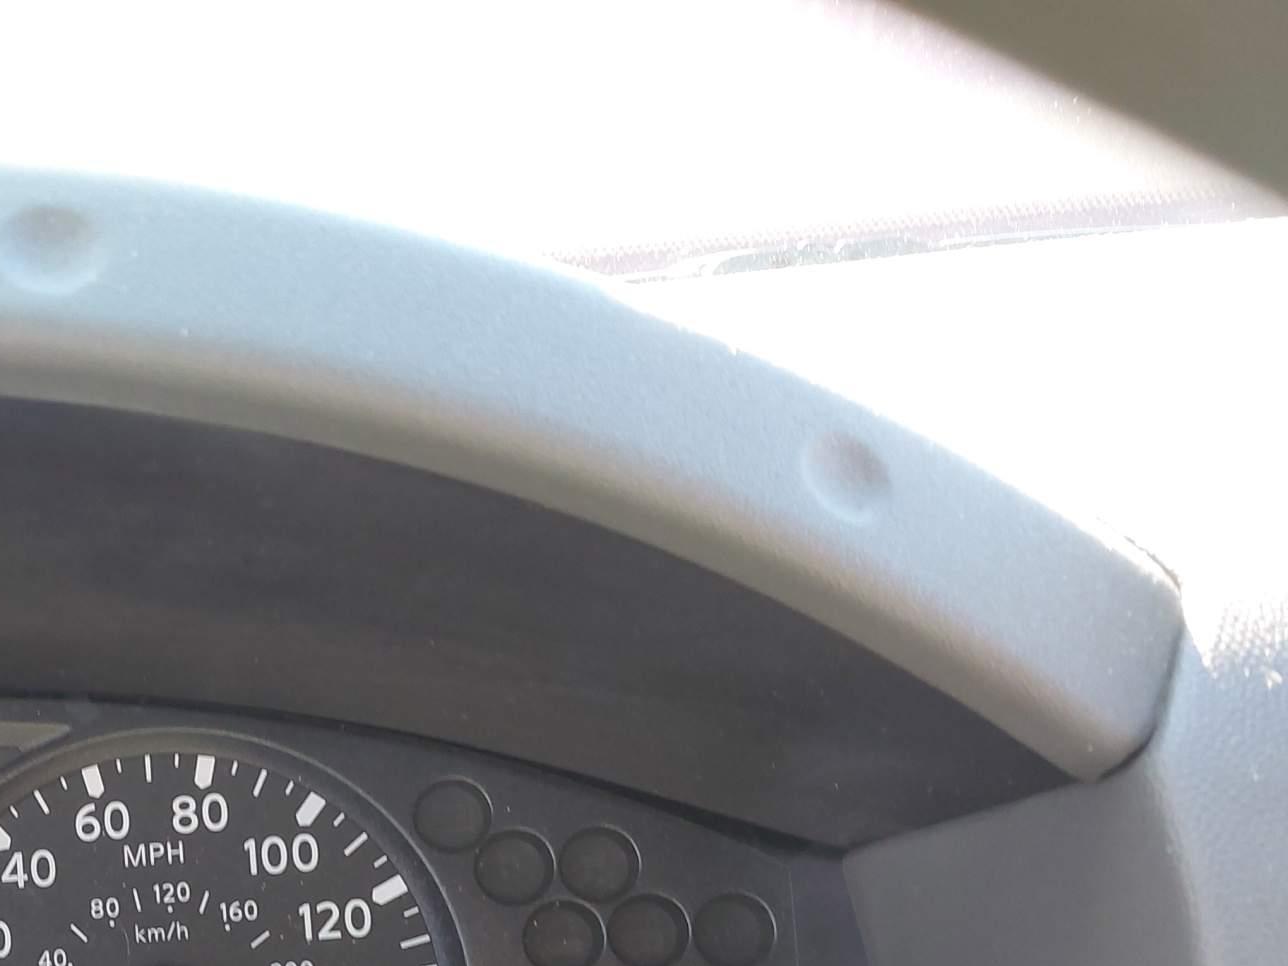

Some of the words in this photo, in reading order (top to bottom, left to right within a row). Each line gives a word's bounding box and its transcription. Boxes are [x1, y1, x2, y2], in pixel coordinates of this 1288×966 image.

[75, 801, 130, 842] 60
[172, 792, 228, 834] 80
[1, 849, 56, 889] 40
[123, 840, 184, 868] MPH
[243, 835, 319, 876] 100
[90, 897, 120, 919] 80
[153, 881, 191, 904] 120
[219, 900, 258, 923] 160
[298, 898, 372, 942] 120
[134, 921, 189, 943] km/h
